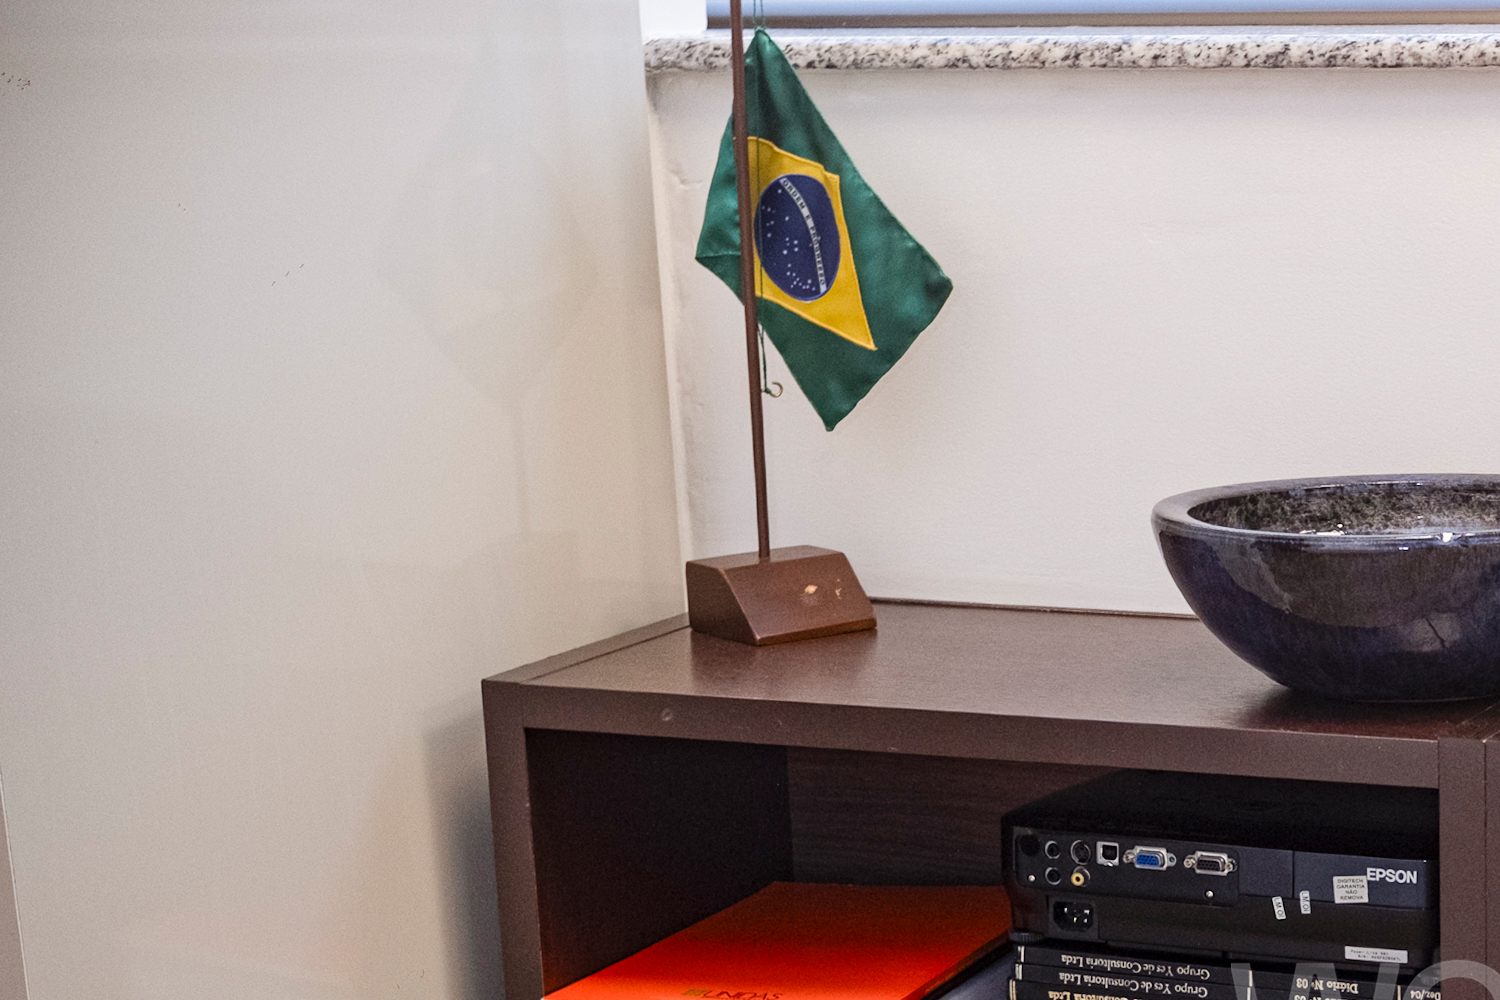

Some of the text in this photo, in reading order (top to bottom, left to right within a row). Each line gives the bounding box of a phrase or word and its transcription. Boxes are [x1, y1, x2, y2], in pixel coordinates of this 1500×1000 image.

[1366, 867, 1418, 884] EPSON
[1060, 954, 1210, 979] Grupo Yes de Consultoria Ltda
